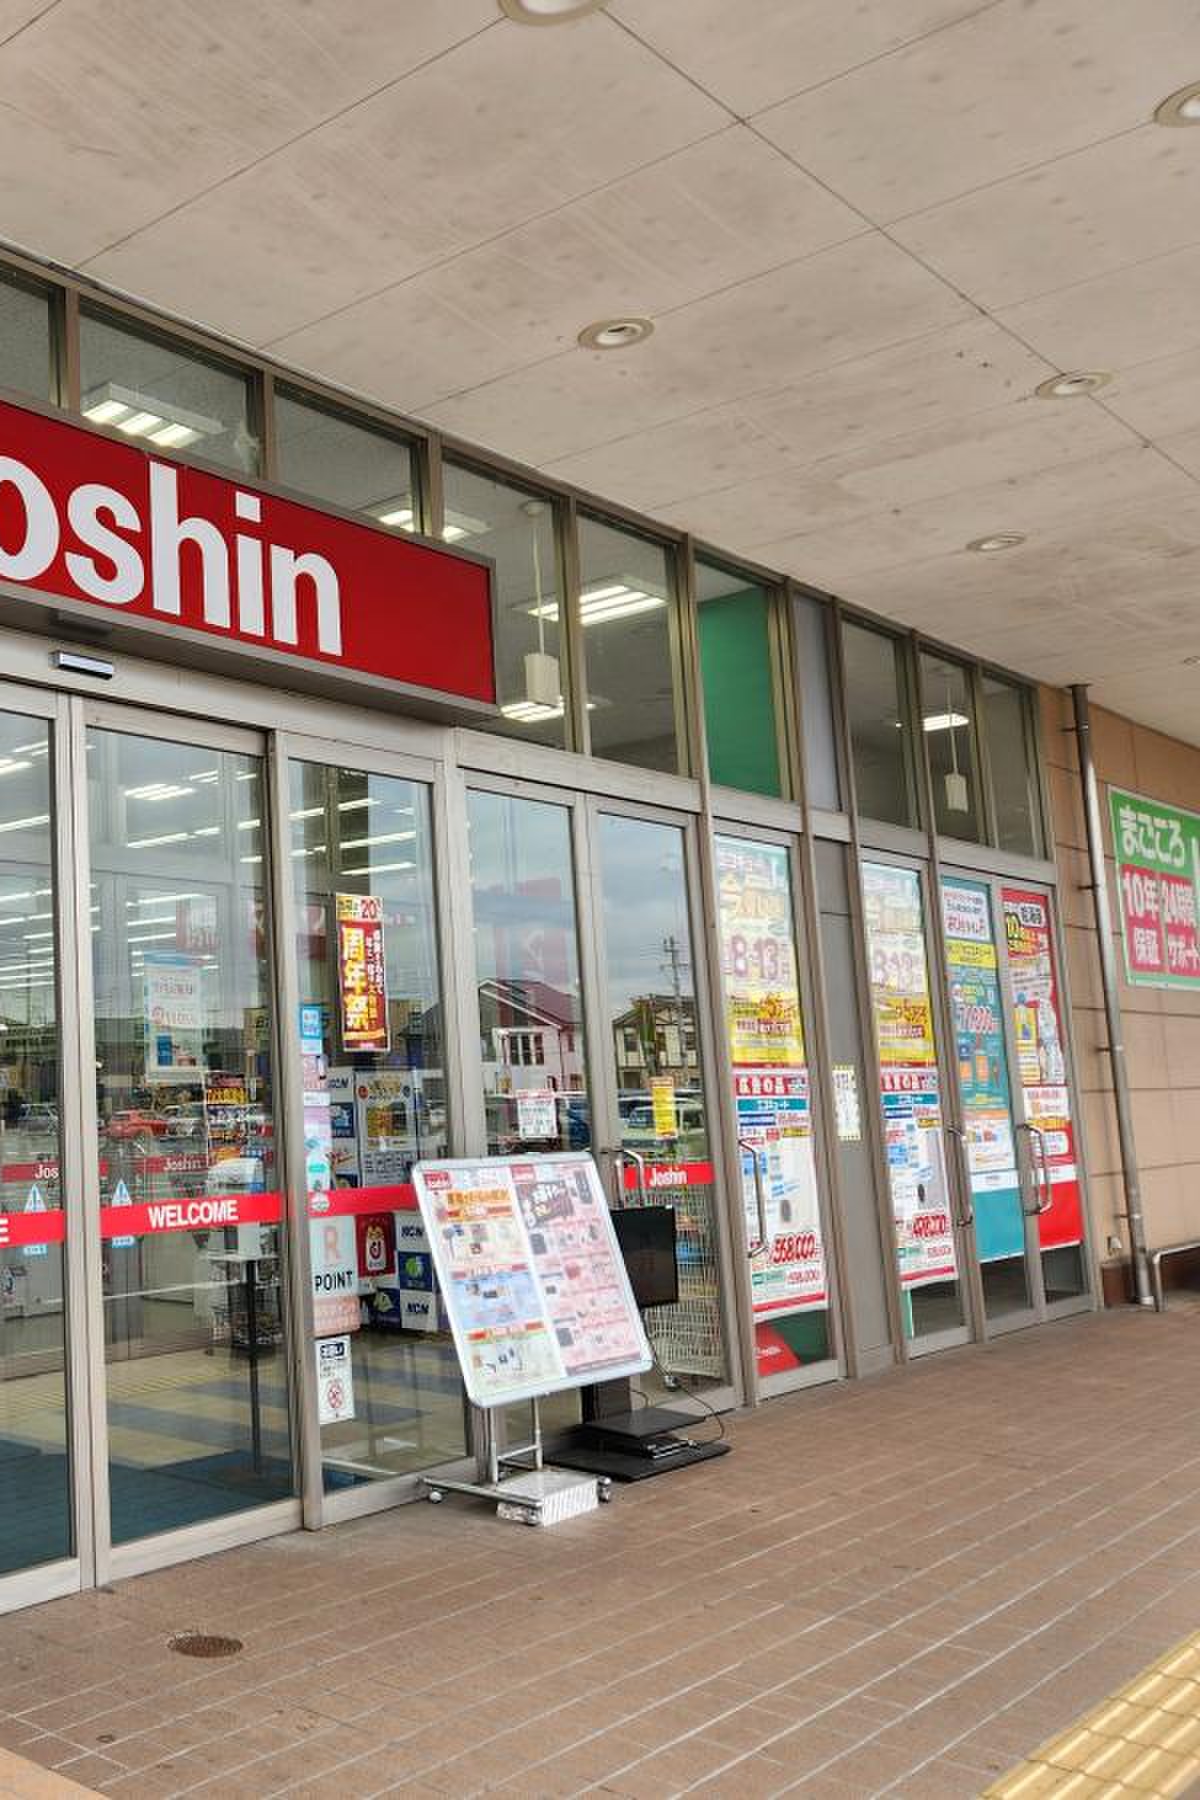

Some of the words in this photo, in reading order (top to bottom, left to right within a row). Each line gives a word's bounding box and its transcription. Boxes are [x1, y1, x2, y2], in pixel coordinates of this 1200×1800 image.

[343, 927, 368, 1030] 周年祭
[650, 1167, 688, 1186] Joshin
[148, 1200, 239, 1228] WELCOME
[315, 1272, 353, 1291] POINT
